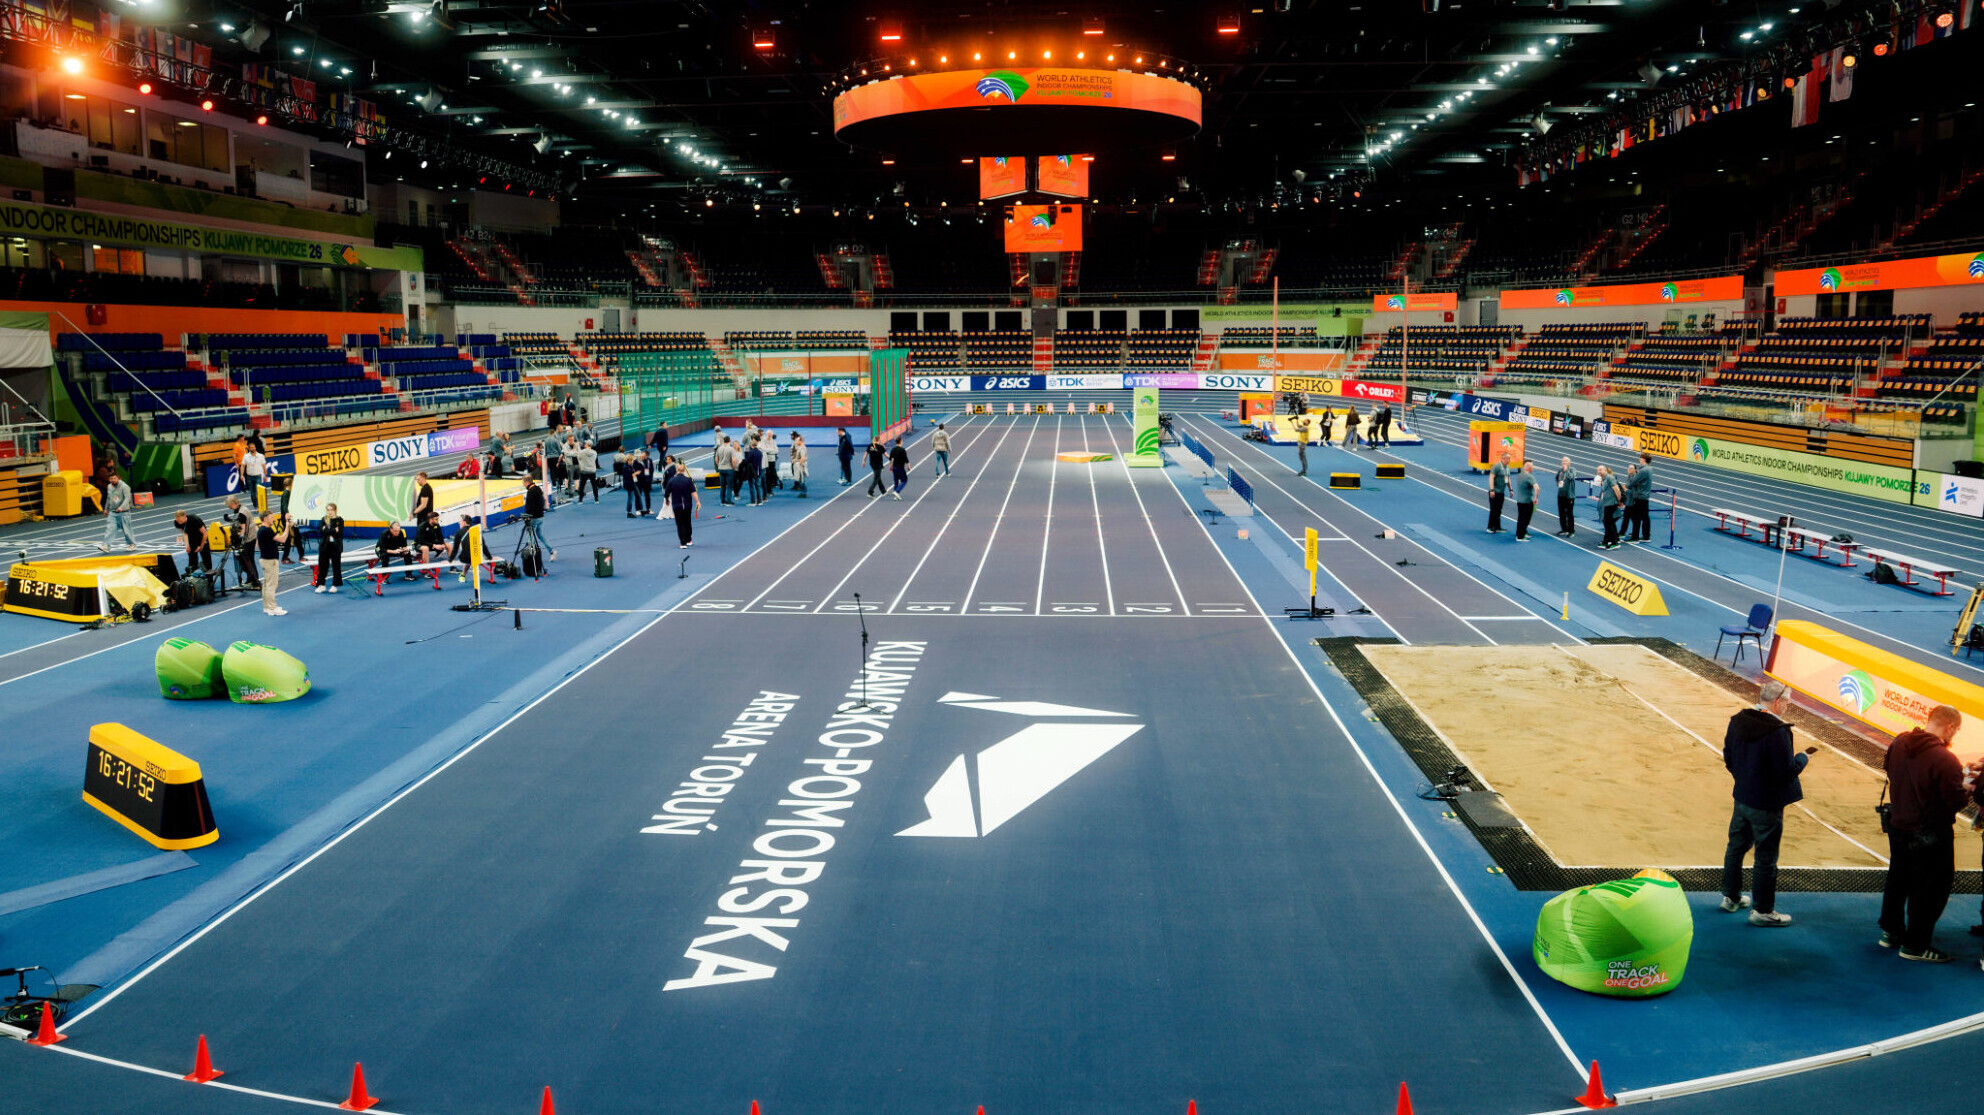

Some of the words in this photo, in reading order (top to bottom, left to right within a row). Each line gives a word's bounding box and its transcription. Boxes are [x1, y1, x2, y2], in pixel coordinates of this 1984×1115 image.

[1036, 75, 1068, 83] WORLD
[1069, 76, 1113, 85] ATHLETICS
[71, 215, 201, 247] CHAMPIONSHIPS
[203, 232, 254, 252] KUJAWY
[255, 238, 308, 259] POMORZE
[309, 245, 323, 259] 26
[905, 378, 963, 390] SONY
[998, 377, 1031, 389] asics
[1057, 378, 1084, 387] TDK
[1133, 378, 1161, 387] TDK
[1205, 375, 1266, 389] SONY
[1281, 377, 1333, 393] SEIKO
[1481, 402, 1502, 419] asics
[434, 434, 456, 451] TDK
[1640, 430, 1680, 456] SEIKO
[373, 438, 423, 464] SONY
[305, 447, 360, 476] SEIKO
[1712, 448, 1731, 460] WORLD
[1731, 451, 1762, 466] ATHLETICS
[1762, 457, 1787, 470] INDOOR
[1787, 460, 1844, 481] CHAMPIONSHIPS
[1844, 470, 1876, 486] KUJAWY
[1919, 482, 1931, 495] 26
[11, 567, 38, 580] SEIKO
[19, 579, 69, 600] 16:21:52
[1597, 569, 1643, 604] SEIKO
[692, 602, 736, 610] 8
[833, 604, 880, 612] 6
[905, 604, 952, 612] 5
[1051, 605, 1099, 613] 3
[1125, 605, 1173, 613] 2
[240, 687, 266, 696] TRACK
[252, 690, 277, 701] GOAL
[1884, 689, 1909, 706] WORLD
[1881, 698, 1902, 712] INDOOR
[712, 690, 802, 749] ARENA
[98, 750, 155, 803] 16:21:52
[145, 760, 167, 781] SEIKO
[638, 752, 758, 836] TORUŃ
[663, 641, 929, 992] KUJAWSKO-POMORSKA
[1607, 964, 1659, 979] TRACK
[1608, 960, 1632, 969] ONE
[1604, 978, 1629, 987] ONE
[1627, 971, 1669, 989] GOAL
